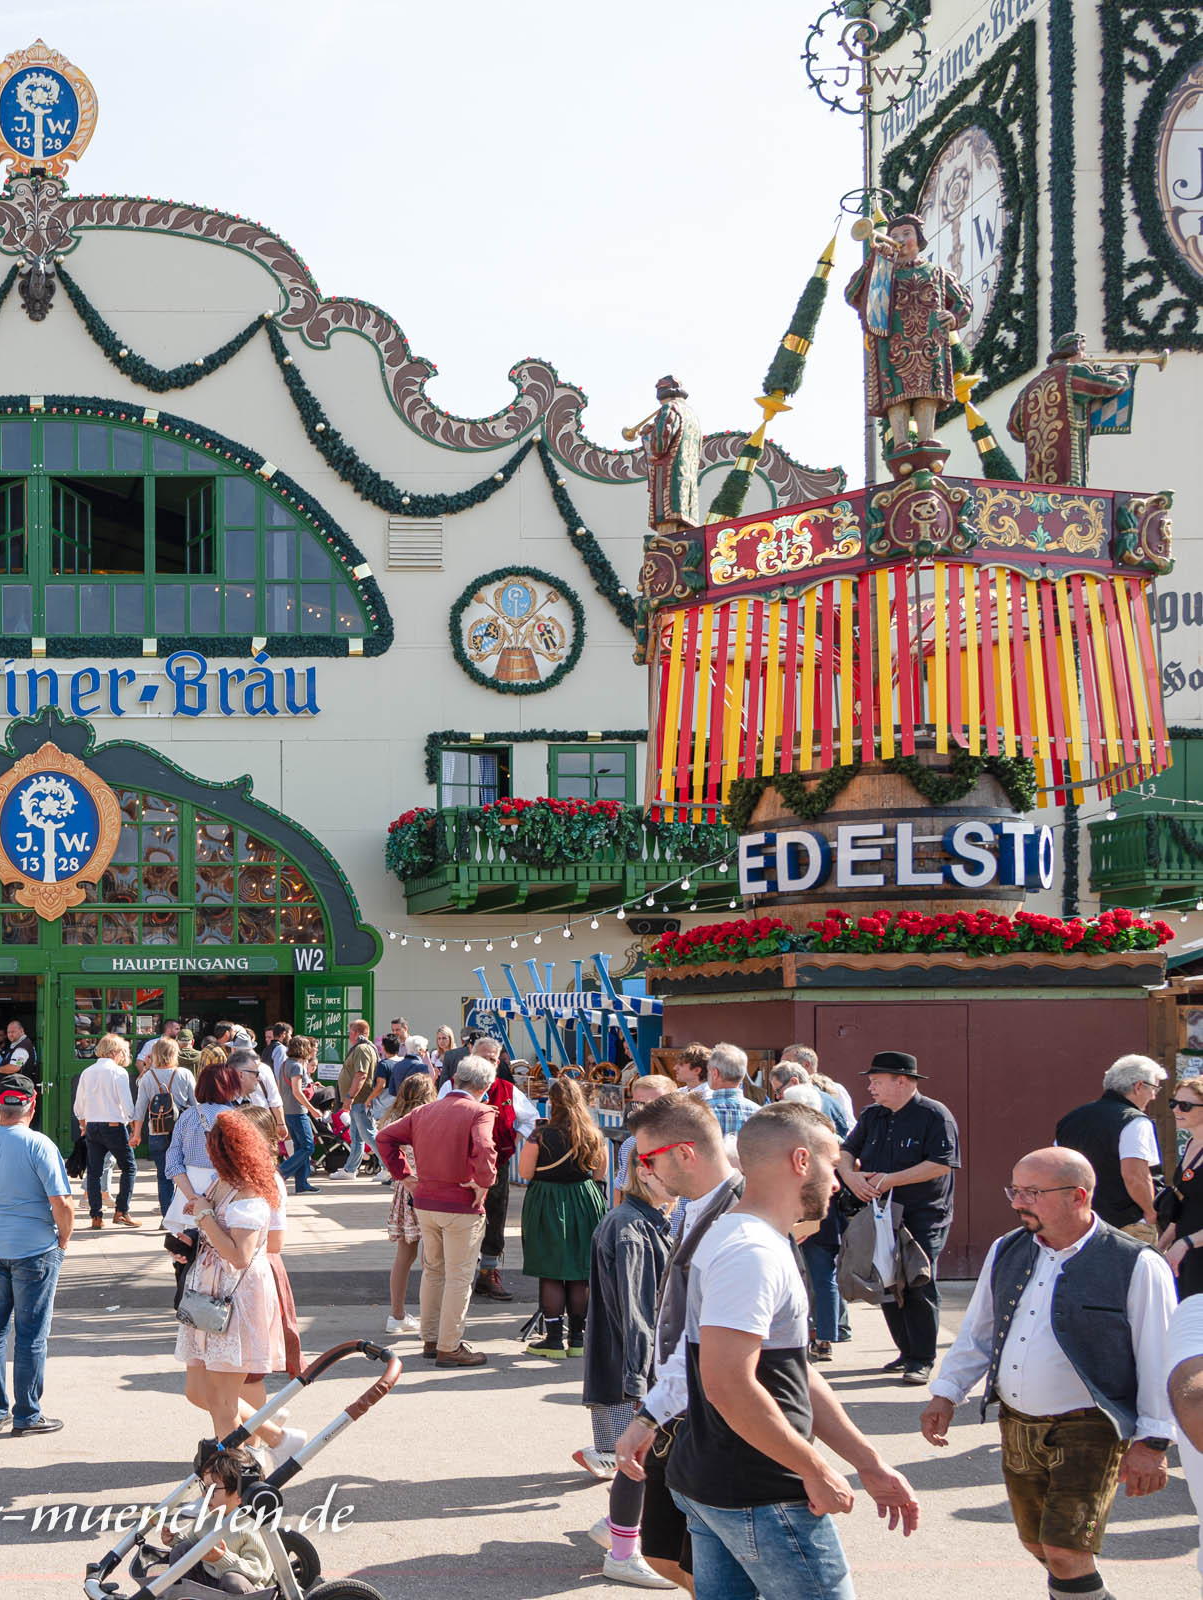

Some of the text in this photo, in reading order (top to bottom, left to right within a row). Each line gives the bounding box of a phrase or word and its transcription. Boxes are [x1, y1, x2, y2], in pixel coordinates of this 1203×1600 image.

[14, 136, 62, 150] 13 28
[20, 857, 80, 872] 13 28
[111, 957, 249, 971] HAUPTEINGANG
[295, 948, 325, 971] W2
